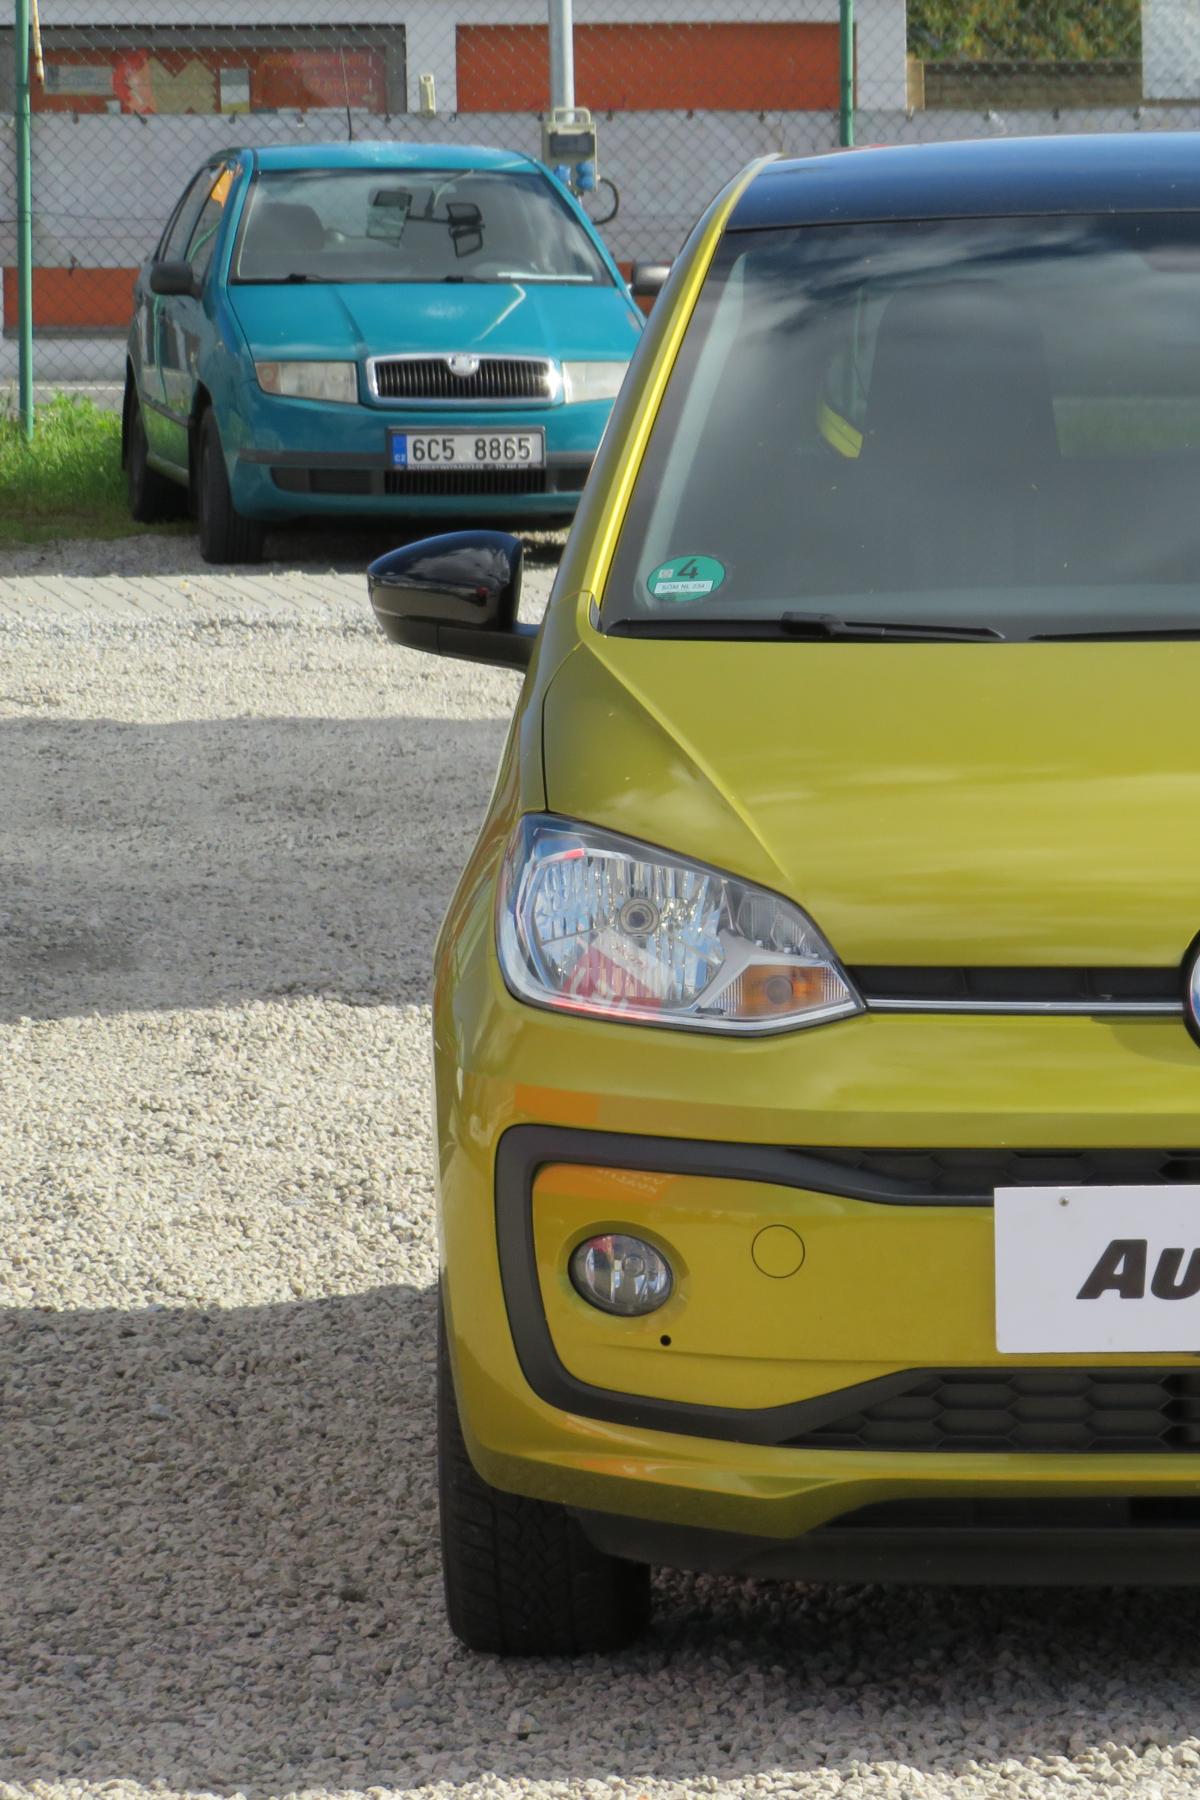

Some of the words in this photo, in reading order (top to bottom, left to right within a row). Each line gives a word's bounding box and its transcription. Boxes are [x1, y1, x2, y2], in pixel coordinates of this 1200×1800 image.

[412, 437, 455, 461] 6C5
[474, 437, 532, 461] 8865
[677, 558, 699, 579] 4
